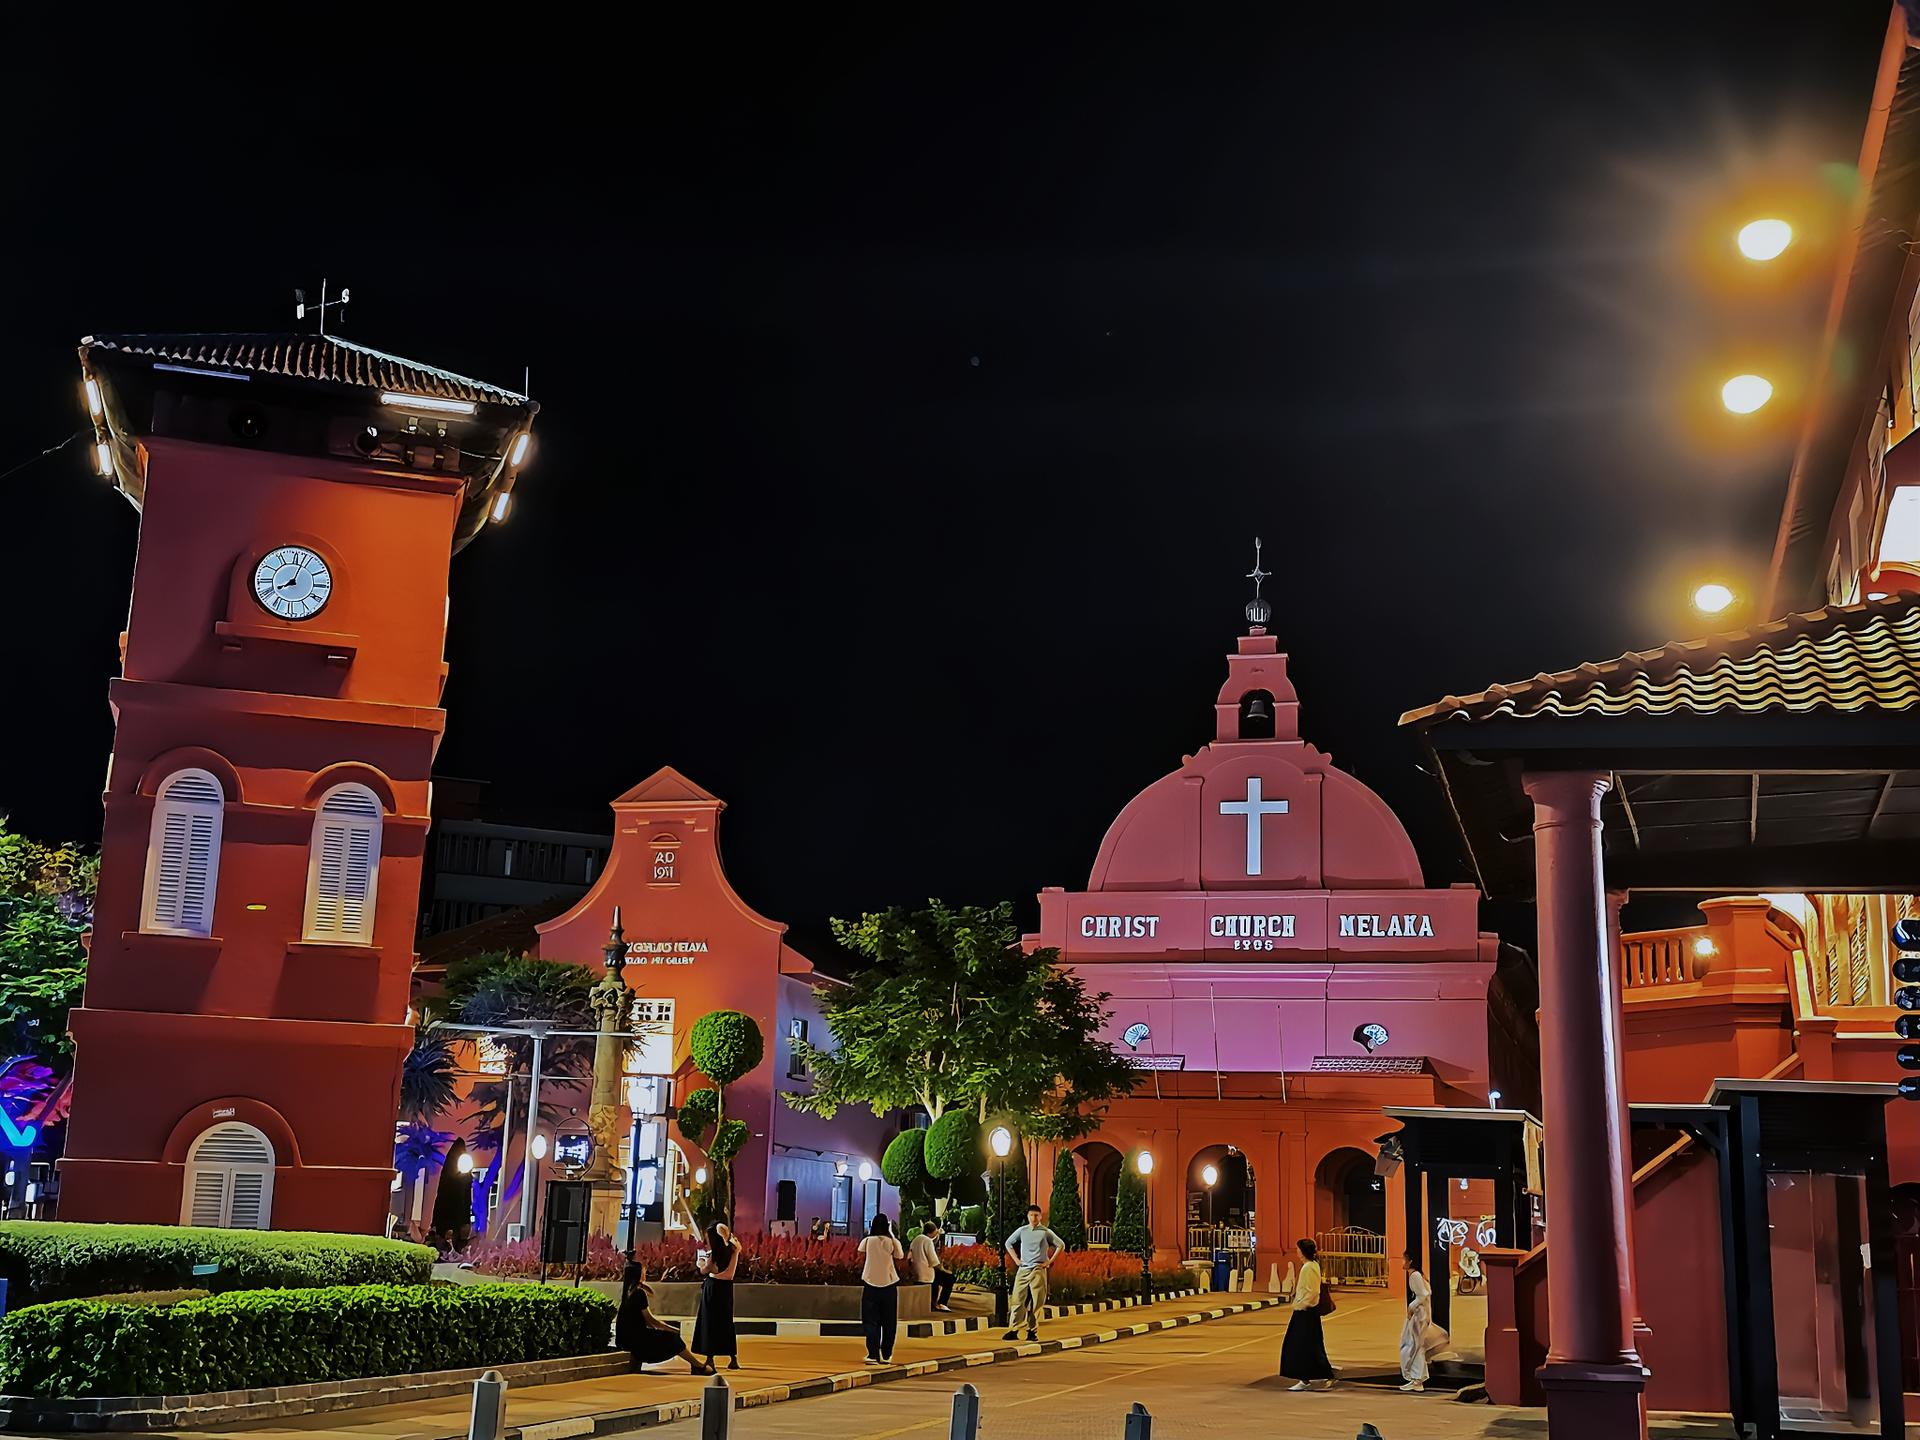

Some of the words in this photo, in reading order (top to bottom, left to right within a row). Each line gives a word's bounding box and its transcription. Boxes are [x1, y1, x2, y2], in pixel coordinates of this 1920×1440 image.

[1081, 915, 1160, 938] CHRIST
[1210, 915, 1296, 937] CHURCH
[1339, 914, 1434, 937] MELAKA
